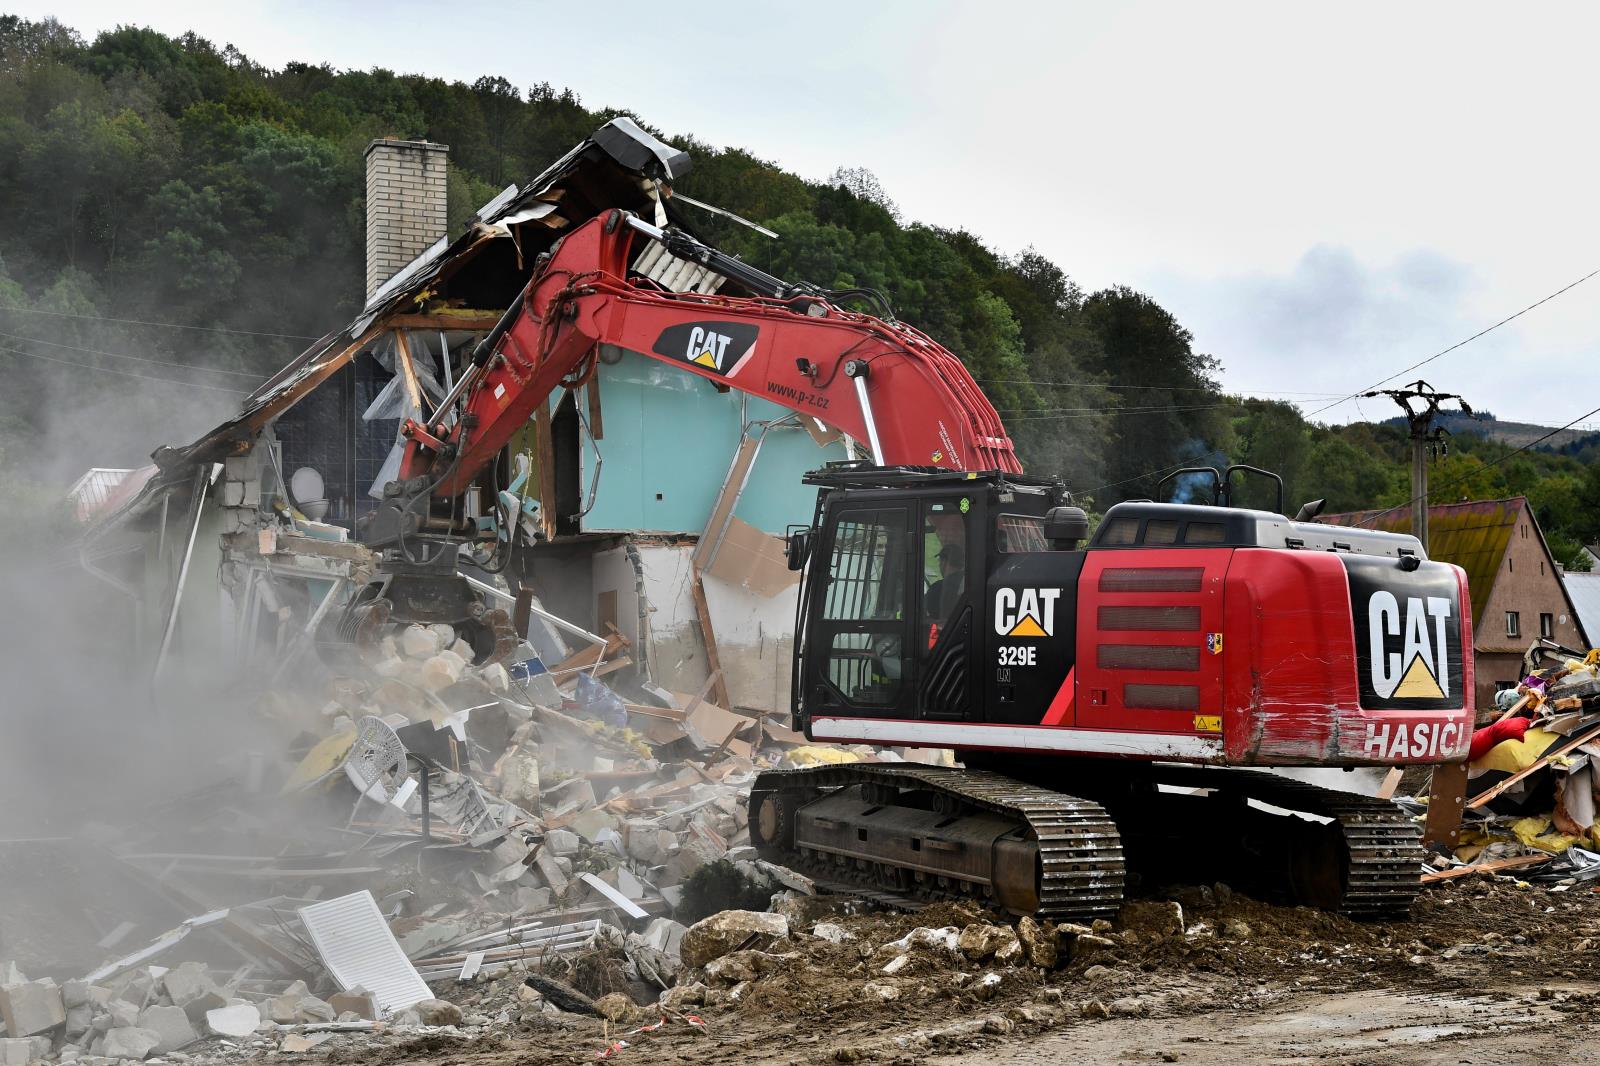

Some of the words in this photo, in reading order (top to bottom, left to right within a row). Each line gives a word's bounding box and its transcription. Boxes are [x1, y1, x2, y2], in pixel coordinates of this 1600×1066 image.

[686, 326, 733, 370] CAT
[767, 381, 830, 409] www.p-z.cz
[994, 587, 1061, 637] CAT
[998, 646, 1037, 666] 329E
[1368, 590, 1452, 700] CAT
[997, 668, 1011, 682] LN
